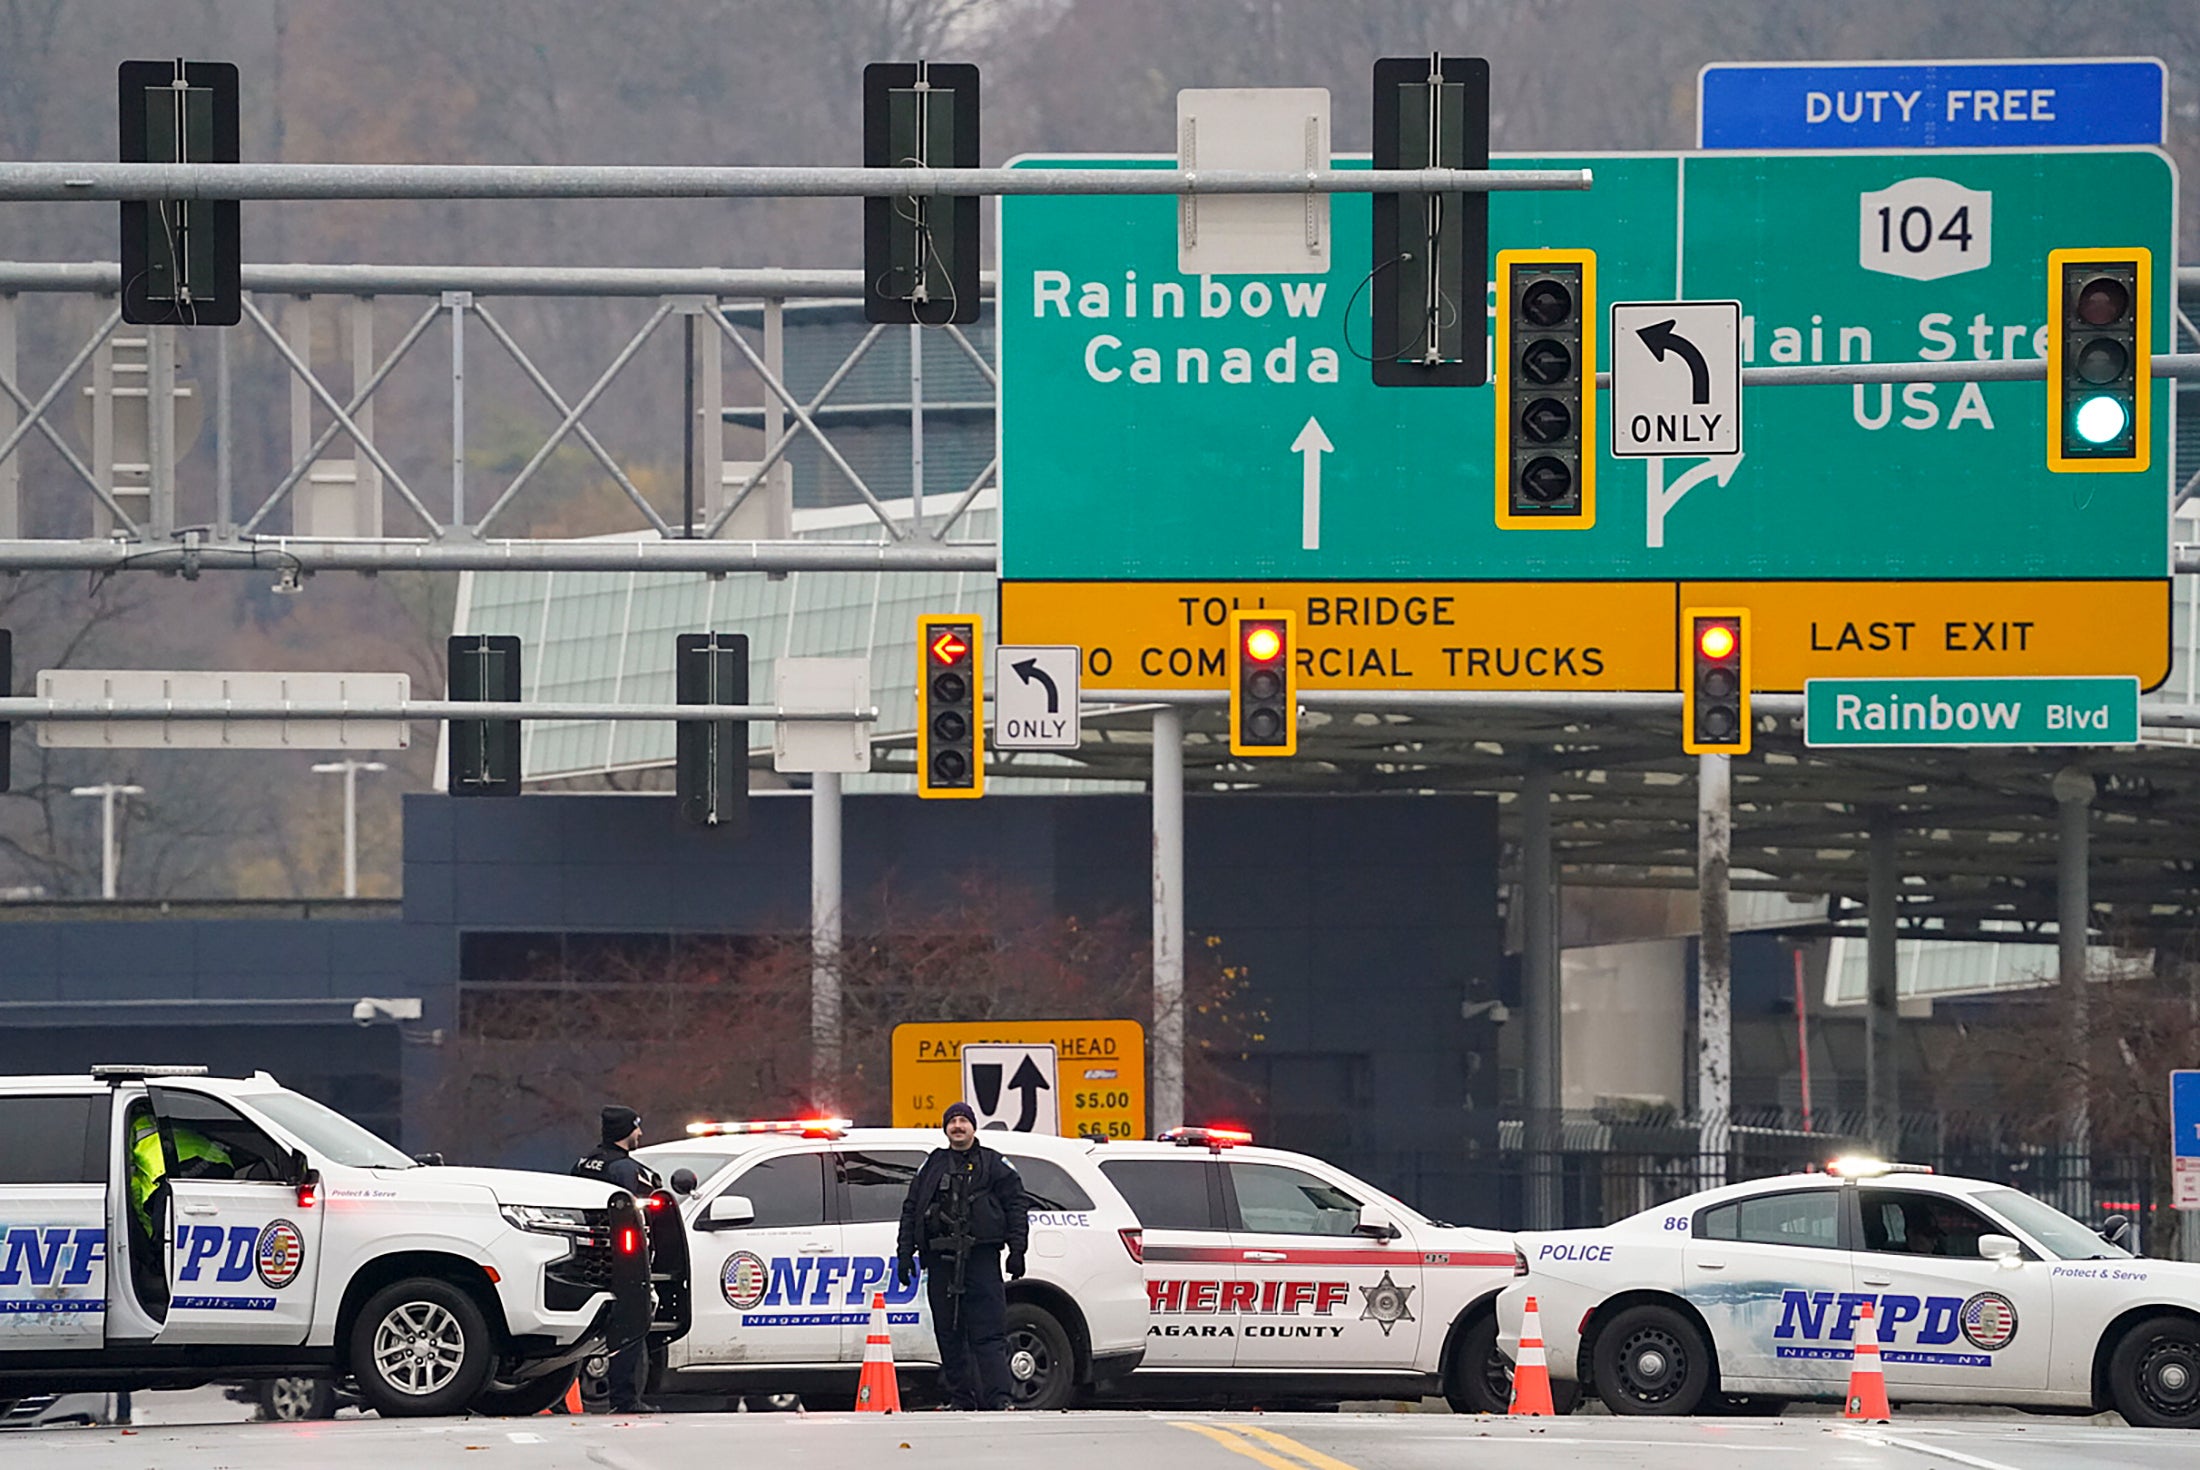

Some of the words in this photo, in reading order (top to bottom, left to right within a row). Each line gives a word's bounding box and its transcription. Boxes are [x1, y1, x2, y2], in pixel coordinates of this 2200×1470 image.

[1806, 91, 1922, 123] DUTY
[1947, 89, 2056, 122] FREE
[1878, 205, 1973, 253] 104
[1033, 270, 1327, 318] Rainbow
[1085, 334, 1339, 383] Canada
[1853, 382, 1995, 431] USA
[1631, 414, 1722, 443] ONLY
[1307, 597, 1455, 626] BRIDGE
[1811, 621, 1916, 652] LAST
[1945, 621, 2035, 651] EXIT
[1080, 647, 1112, 677] O
[1140, 647, 1413, 677] COMRCIAL
[1442, 647, 1604, 677] TRUCKS
[1836, 694, 2022, 731] Rainbow
[2046, 704, 2109, 730] Blvd
[1006, 719, 1067, 739] ONLY
[919, 1040, 962, 1057] PAY
[1048, 1037, 1117, 1056] HEAD
[1075, 1092, 1129, 1109] $5.00
[1077, 1121, 1131, 1138] $650
[372, 1190, 397, 1198] Serve
[1028, 1213, 1090, 1228] POLICE
[1664, 1217, 1689, 1231] 86
[1539, 1245, 1614, 1262] POLICE
[764, 1256, 921, 1306] NFPD
[2052, 1266, 2097, 1279] Protect
[2099, 1269, 2109, 1279] &
[2112, 1269, 2148, 1281] Serve
[6, 1302, 105, 1311] Niagara
[247, 1299, 272, 1308] NY
[1146, 1279, 1350, 1316] HERIFF
[747, 1316, 820, 1325] Niagara
[831, 1314, 870, 1324] Fall
[891, 1313, 914, 1323] NY
[1773, 1290, 1964, 1346] NFPD
[1147, 1325, 1235, 1337] AGARA
[1244, 1326, 1344, 1337] COUNTY
[1784, 1348, 1853, 1360] Niaga
[1958, 1355, 1986, 1365] NY
